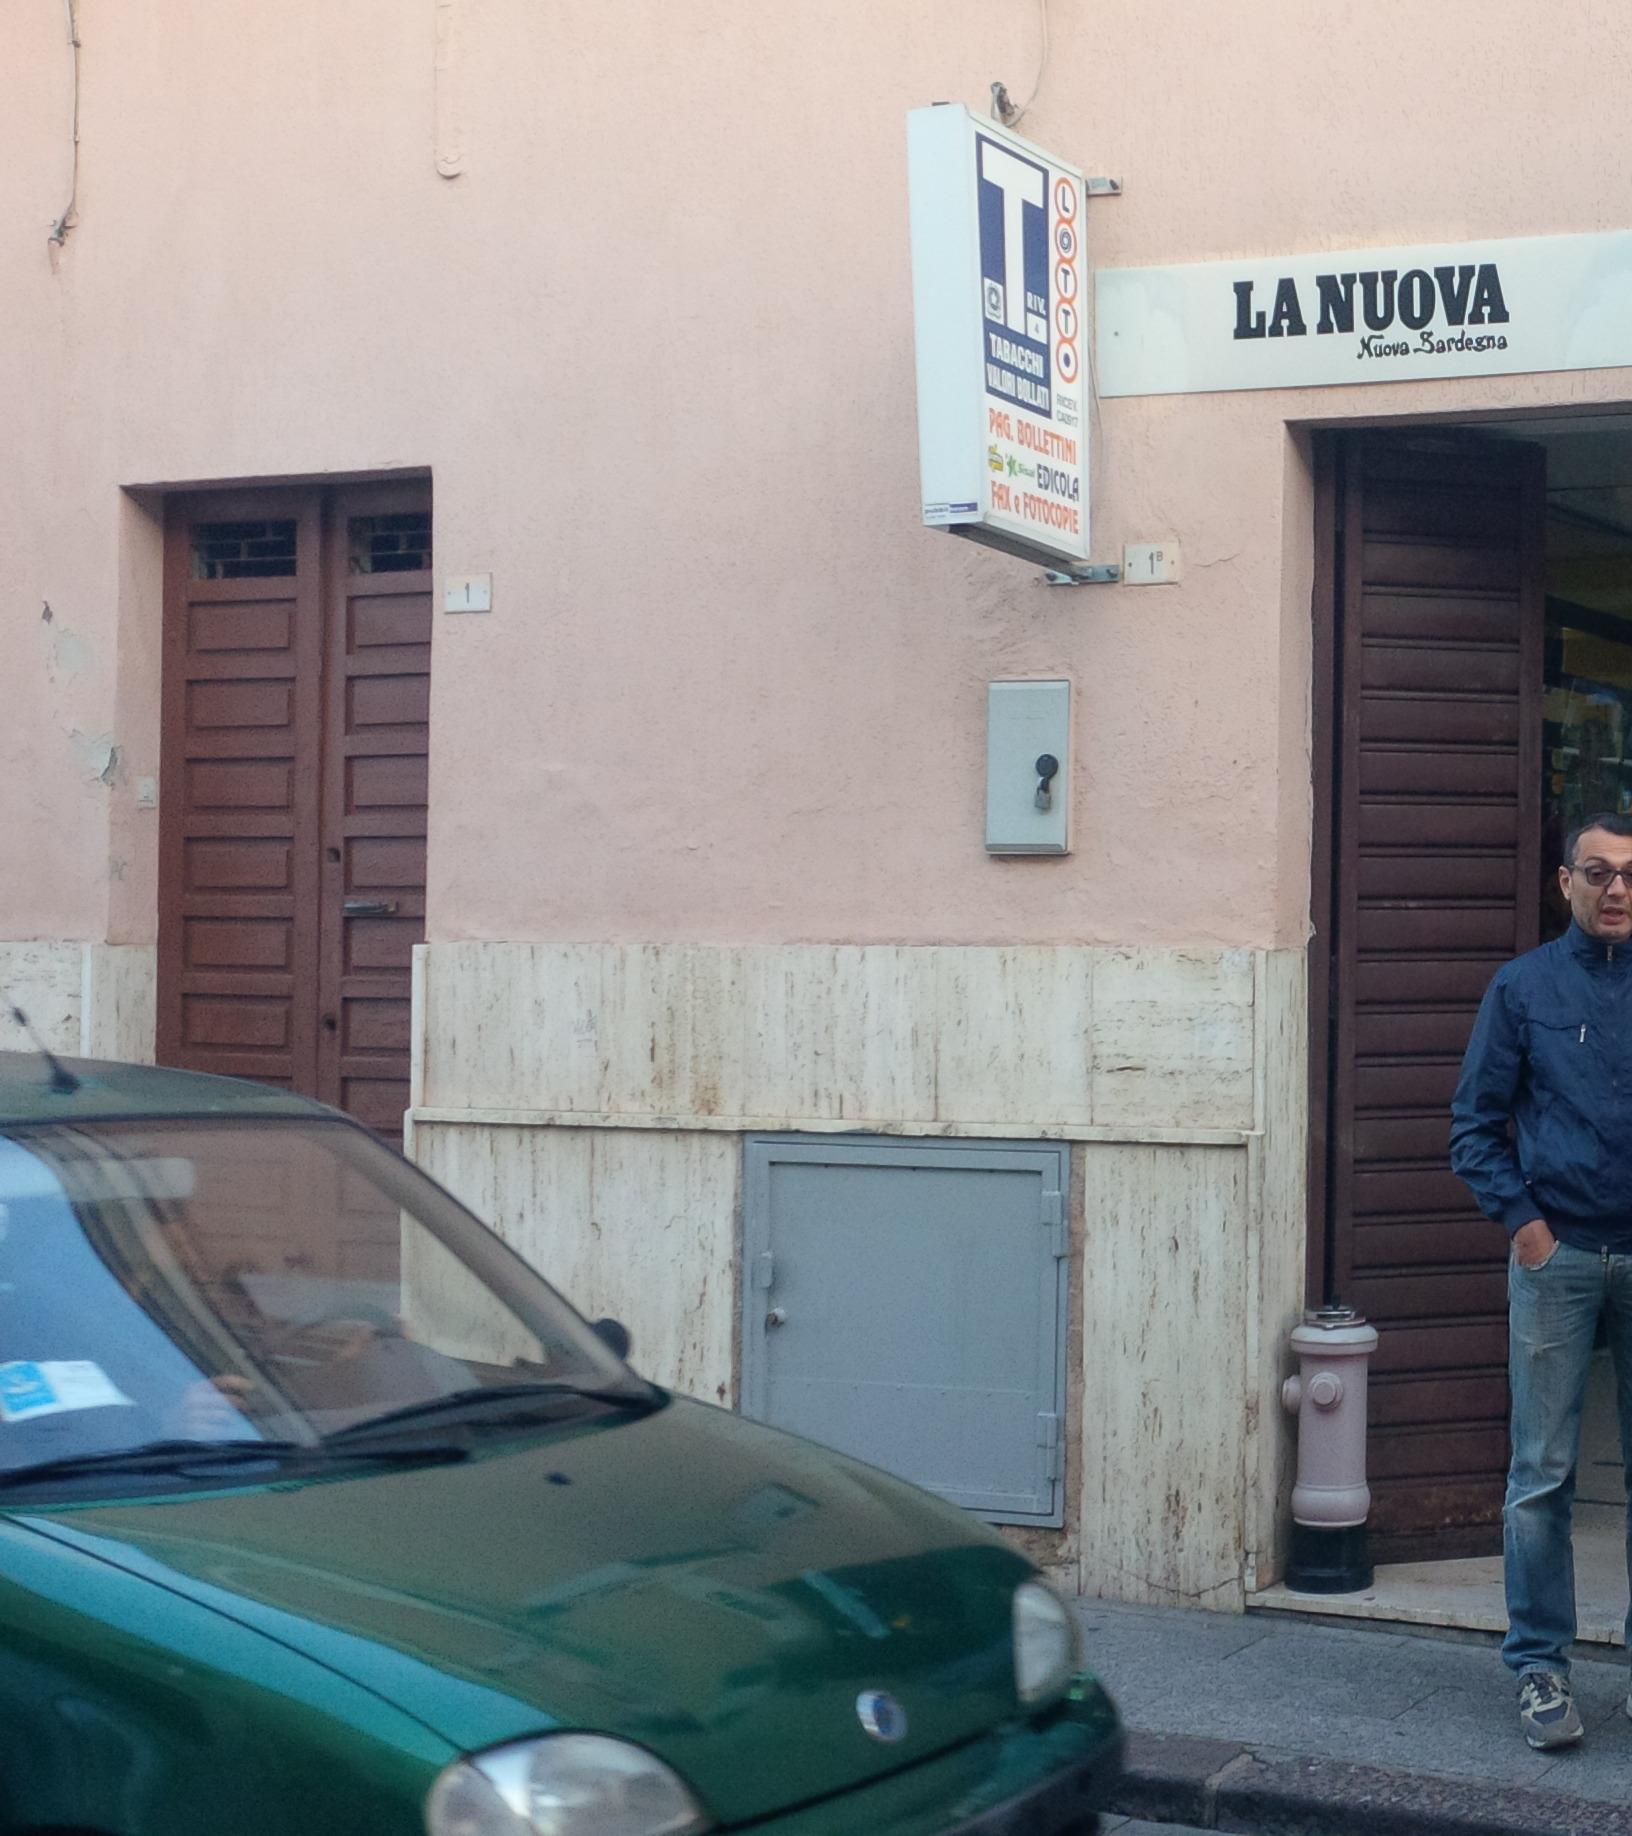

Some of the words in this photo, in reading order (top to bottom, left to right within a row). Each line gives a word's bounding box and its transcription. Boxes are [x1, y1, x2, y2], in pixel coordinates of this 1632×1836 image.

[982, 141, 1044, 335] T
[1233, 277, 1307, 340] LA
[1316, 263, 1510, 335] NUOVA
[989, 332, 1044, 379] TABACCHI
[1356, 334, 1411, 359] Nuova
[1413, 330, 1509, 354] Sardegna
[989, 408, 1014, 441] PAG.
[1017, 419, 1077, 465] BOLLETTINI
[991, 480, 1011, 513] FAX
[1014, 495, 1020, 514] e
[1023, 492, 1079, 534] FOTOCOPIE
[1037, 463, 1080, 502] EDICOLA
[464, 582, 470, 604] 1
